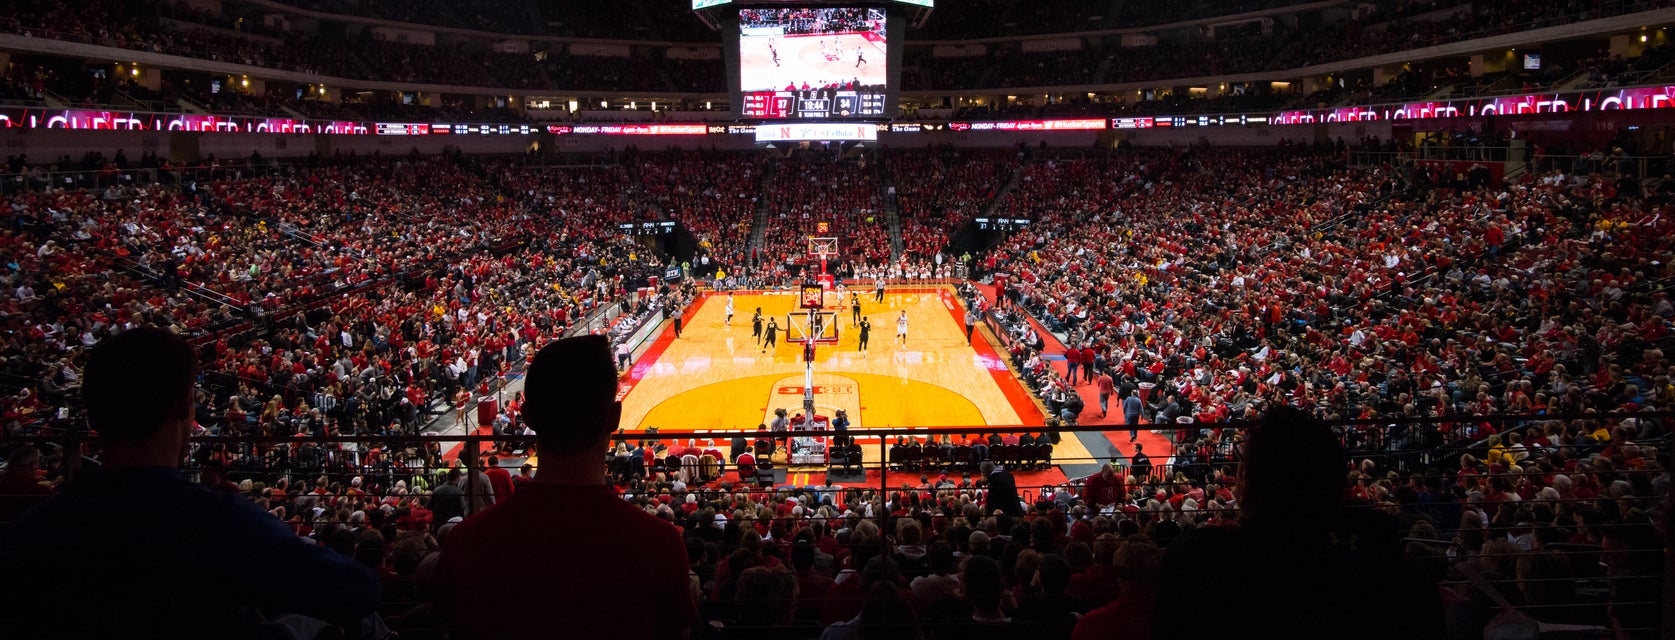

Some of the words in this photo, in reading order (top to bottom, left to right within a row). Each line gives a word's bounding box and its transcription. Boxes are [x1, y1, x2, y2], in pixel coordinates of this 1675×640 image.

[777, 99, 788, 109] 37
[804, 100, 824, 111] 19:44
[840, 98, 851, 109] 34
[659, 125, 706, 134] @HuskerSports
[1054, 120, 1104, 129] @HuskerSports
[1595, 121, 1614, 131] 118
[780, 127, 791, 139] N
[826, 129, 853, 137] Cellular
[857, 126, 866, 138] N
[7, 139, 25, 148] 106
